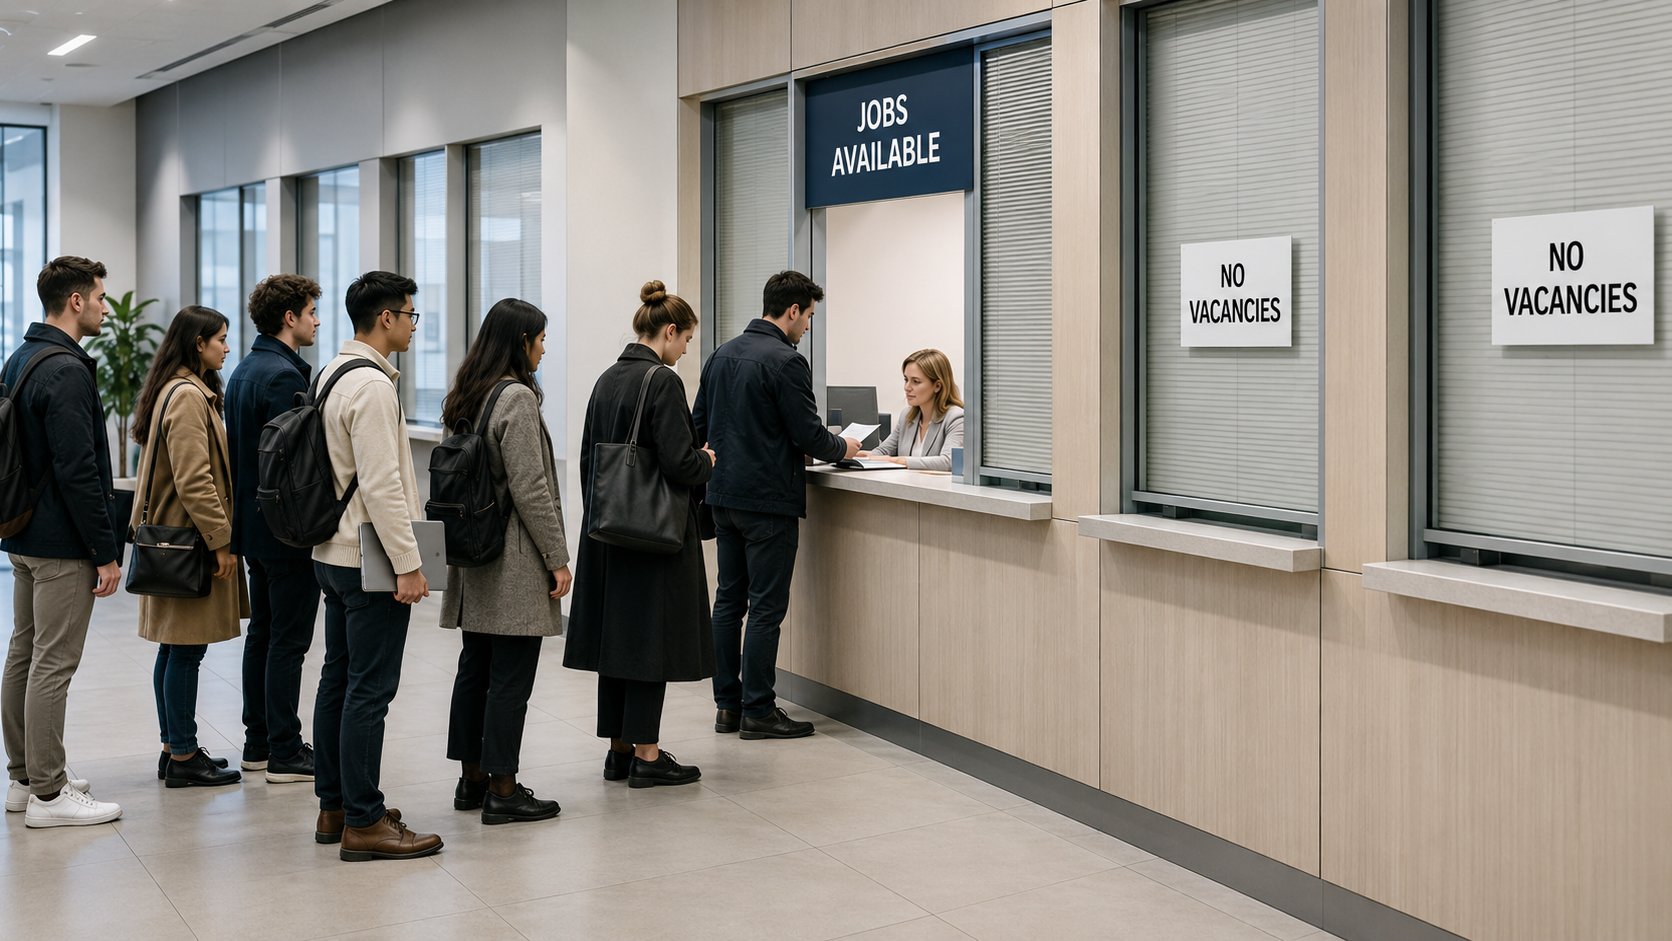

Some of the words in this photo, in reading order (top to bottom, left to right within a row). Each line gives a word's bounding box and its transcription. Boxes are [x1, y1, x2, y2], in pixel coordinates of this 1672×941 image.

[857, 94, 908, 132] JOBS
[831, 131, 941, 177] AVAILABLE
[1549, 240, 1584, 272] NO
[1221, 262, 1245, 288] NO
[1189, 296, 1281, 324] VACANCIES
[1503, 281, 1638, 316] VACANCIES
